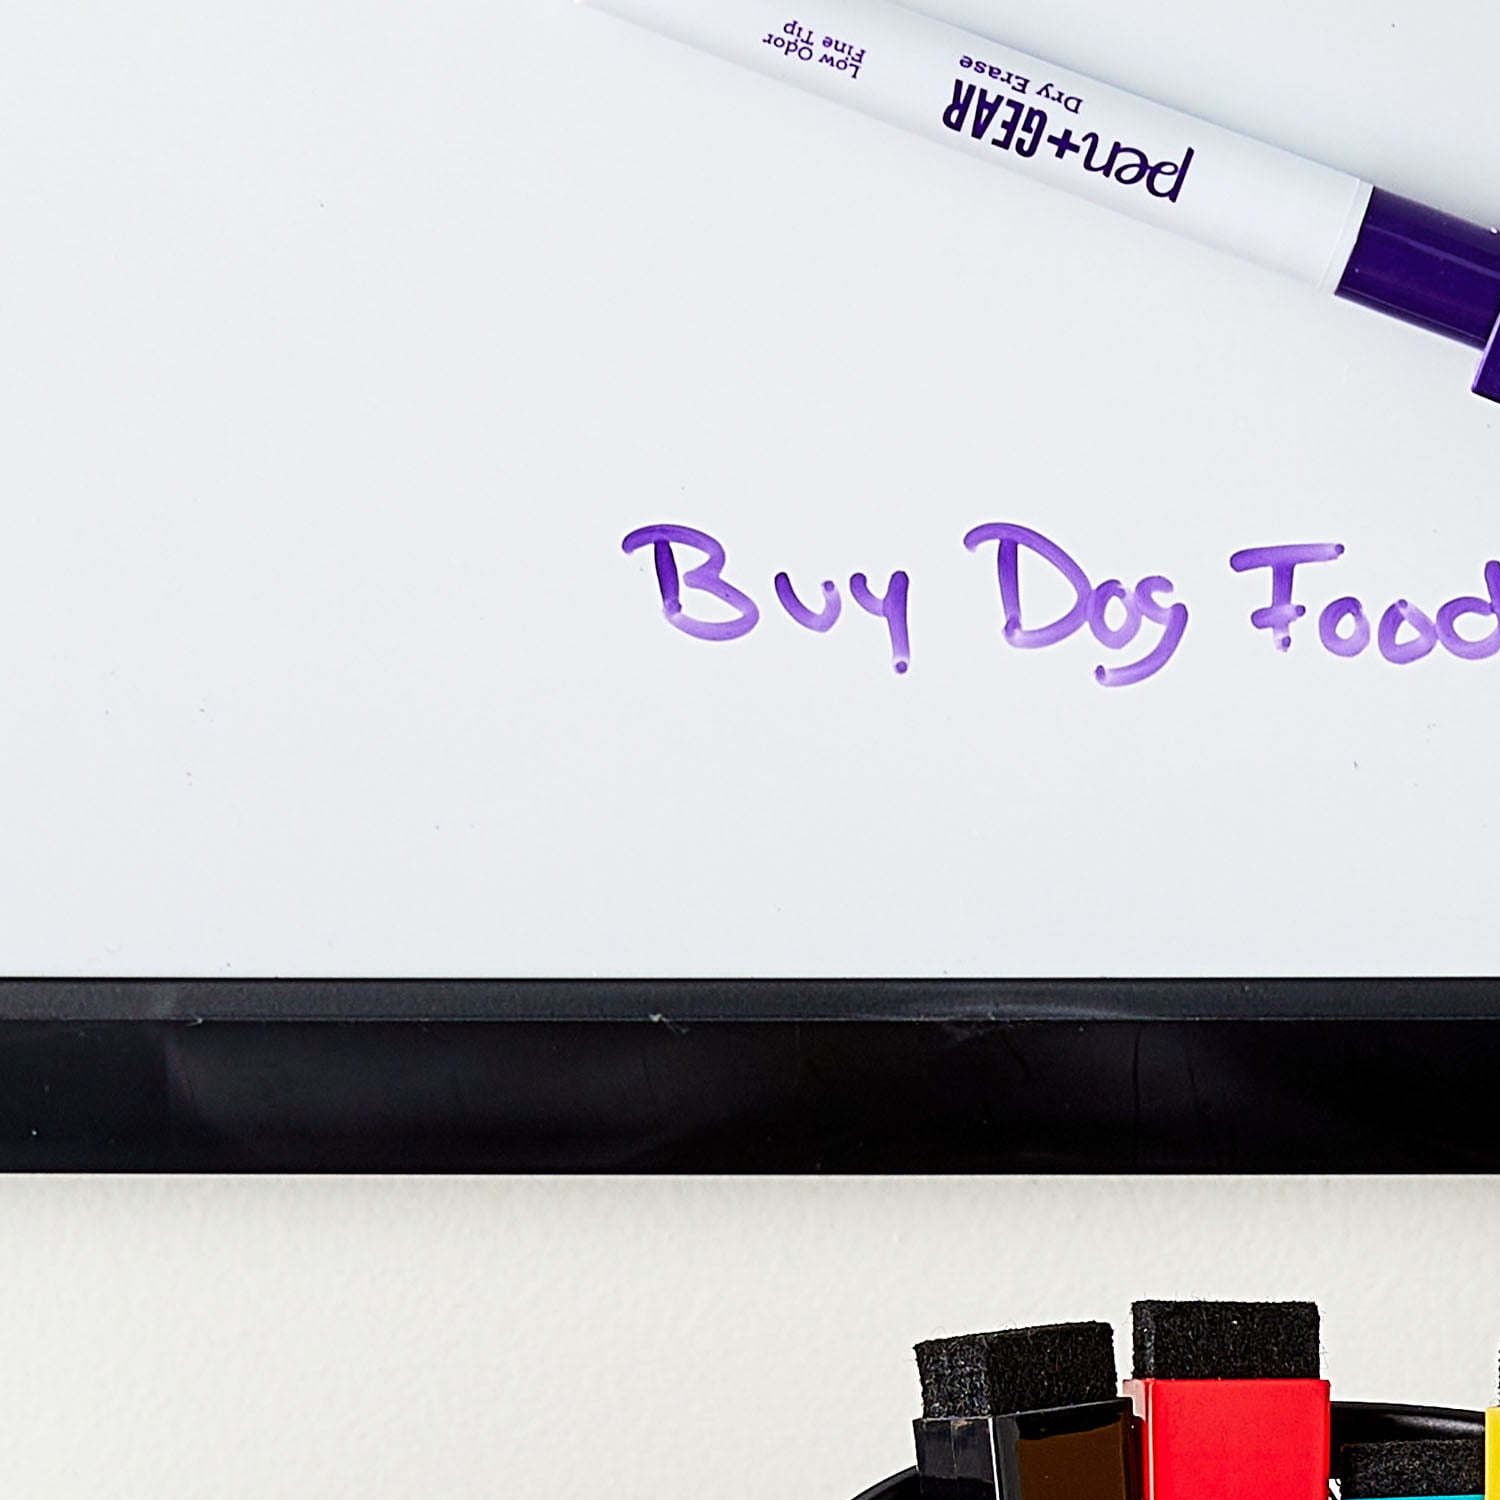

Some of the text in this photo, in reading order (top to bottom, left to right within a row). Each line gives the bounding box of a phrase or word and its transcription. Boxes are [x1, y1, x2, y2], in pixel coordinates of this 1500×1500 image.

[762, 33, 861, 79] Low Odor
[783, 20, 867, 64] Fine Tip
[959, 55, 1084, 115] Dry Erase
[942, 78, 1195, 204] pen+GEAR
[620, 523, 911, 676] Buy
[962, 521, 1190, 688] Dog
